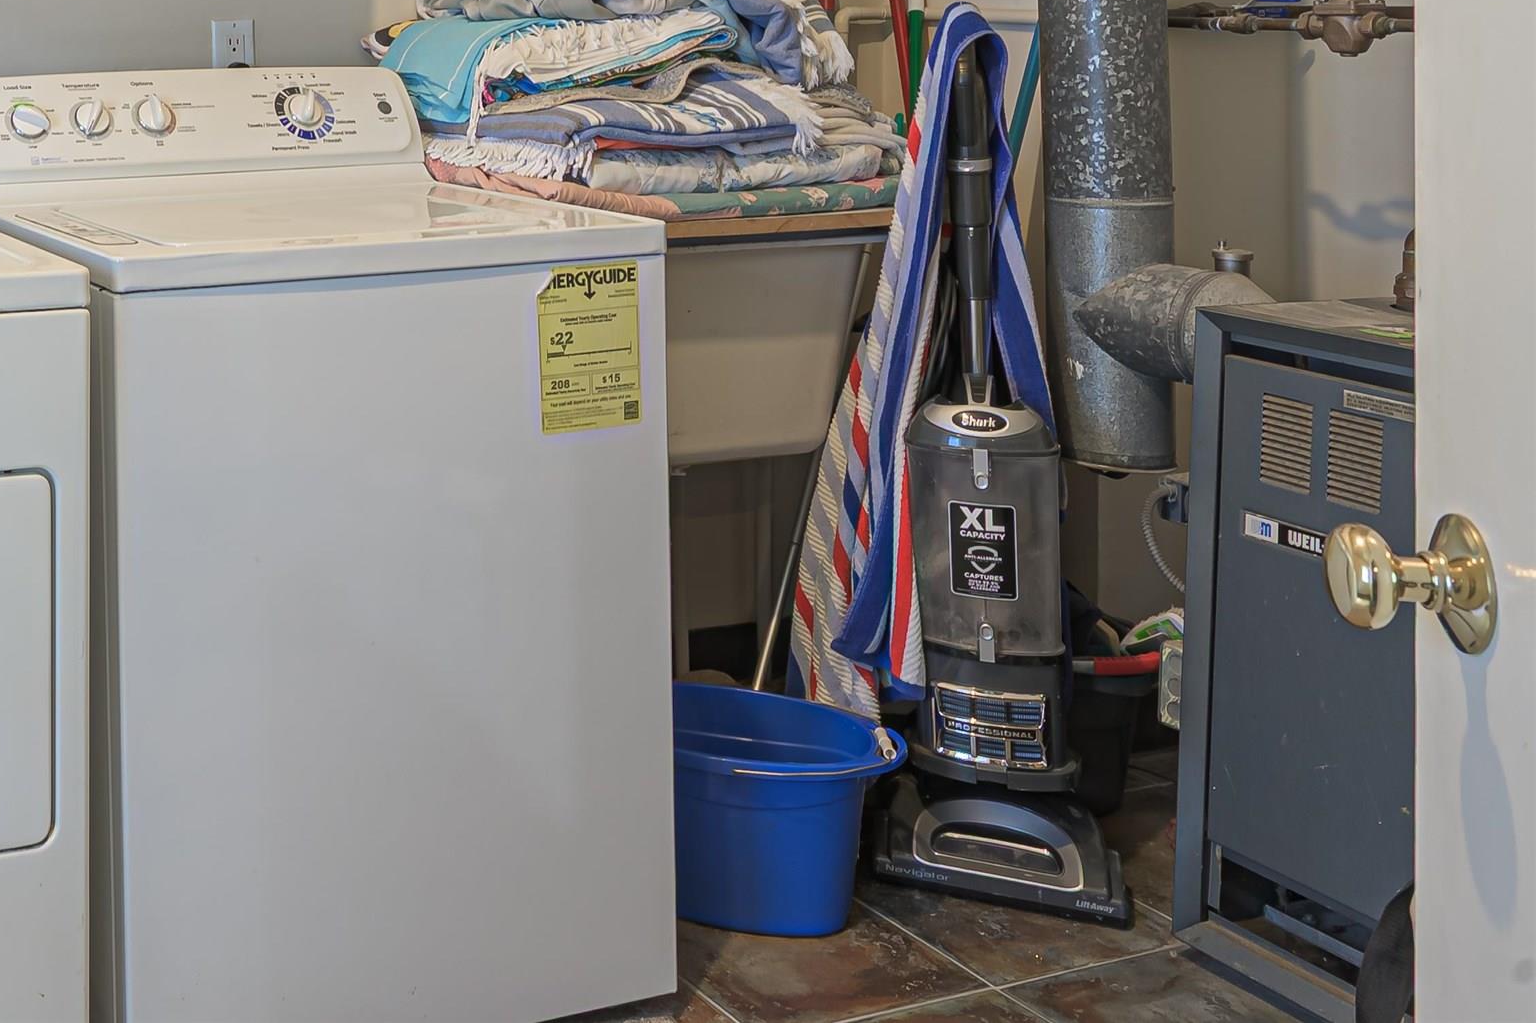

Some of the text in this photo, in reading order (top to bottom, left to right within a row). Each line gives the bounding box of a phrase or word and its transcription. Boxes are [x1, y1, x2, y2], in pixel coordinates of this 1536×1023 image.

[550, 331, 574, 346] $22
[551, 380, 570, 390] 208
[960, 413, 996, 429] Shark
[960, 506, 1005, 533] XL
[960, 530, 1006, 541] CAPACITY
[964, 571, 1004, 582] CAPTURES
[947, 719, 1034, 740] PROFESSIONAL
[885, 863, 951, 882] Navigator
